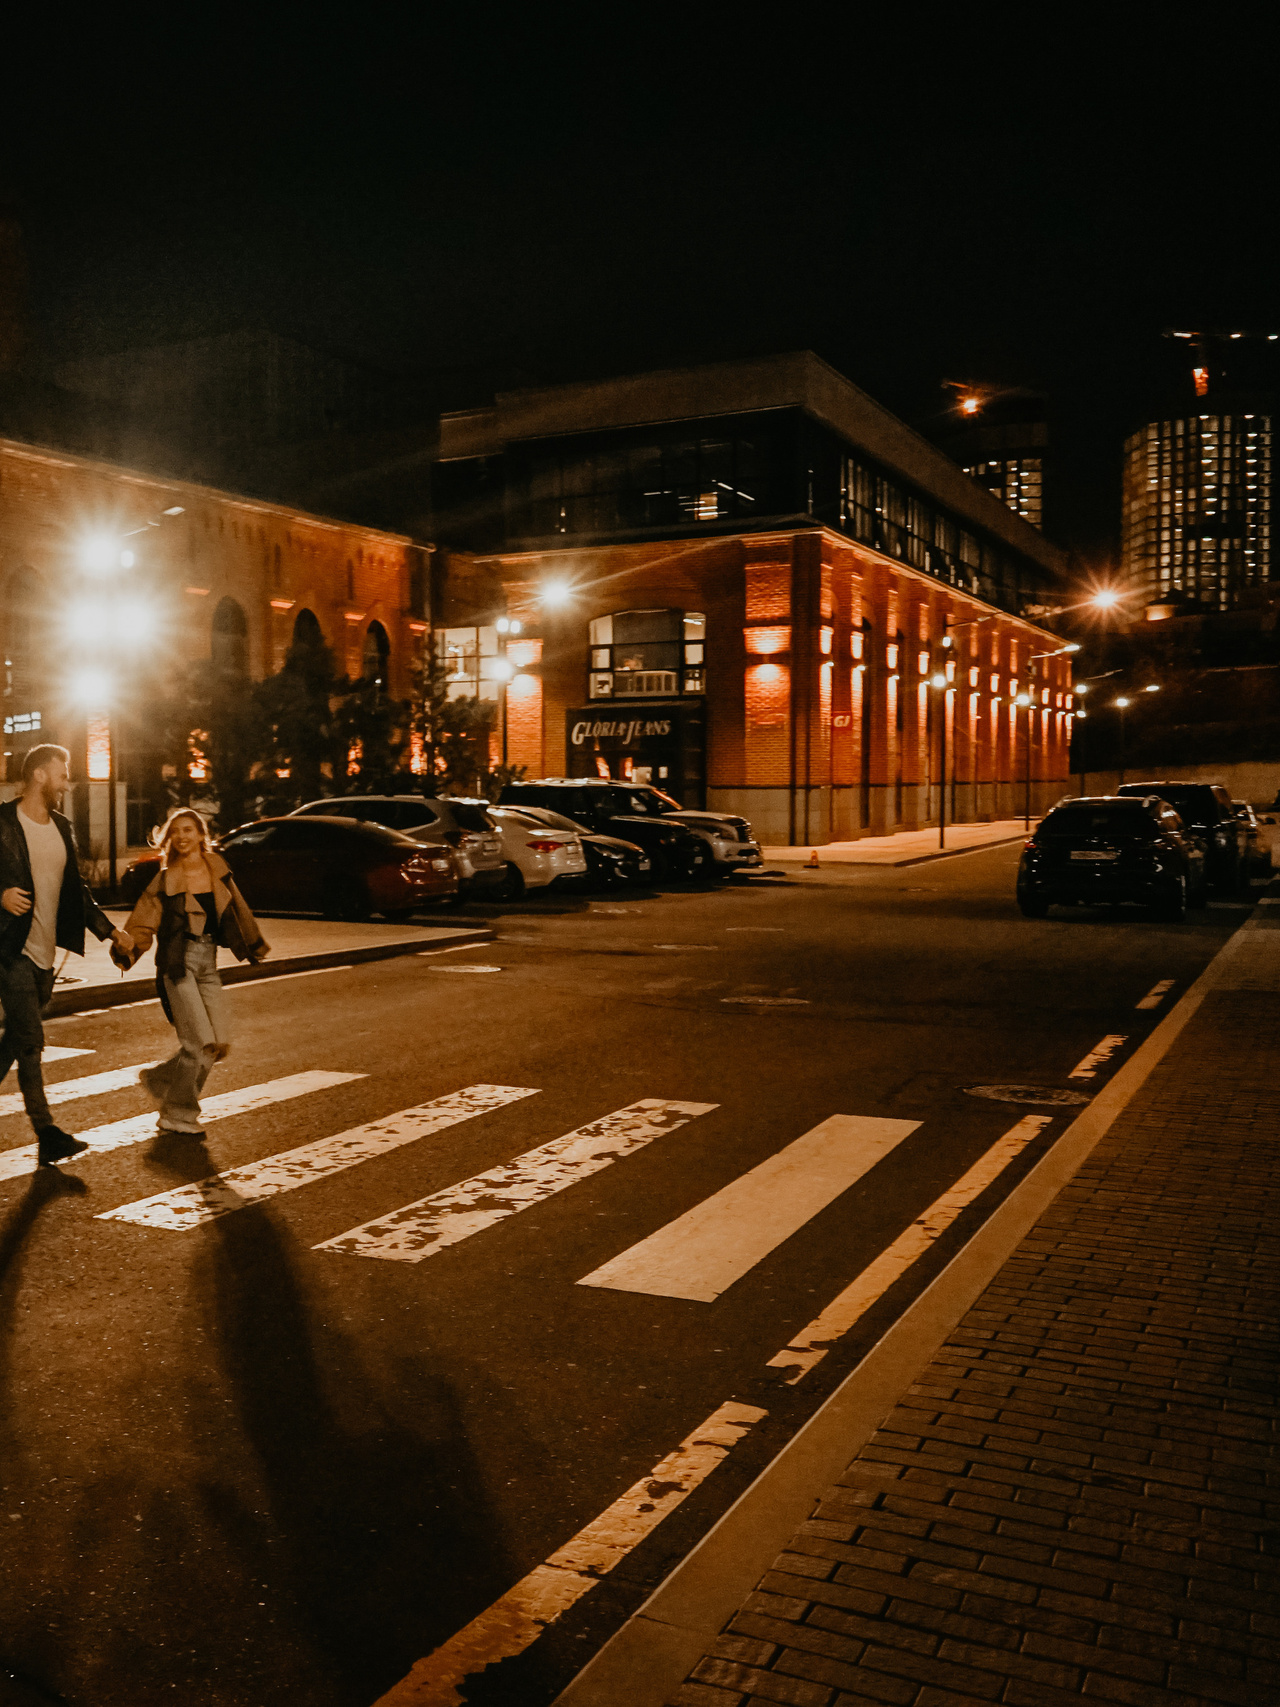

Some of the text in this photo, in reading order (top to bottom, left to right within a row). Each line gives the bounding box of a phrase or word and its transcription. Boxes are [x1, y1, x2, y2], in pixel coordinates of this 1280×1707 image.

[833, 715, 851, 728] GJ
[571, 719, 671, 745] GLORIA JEANS
